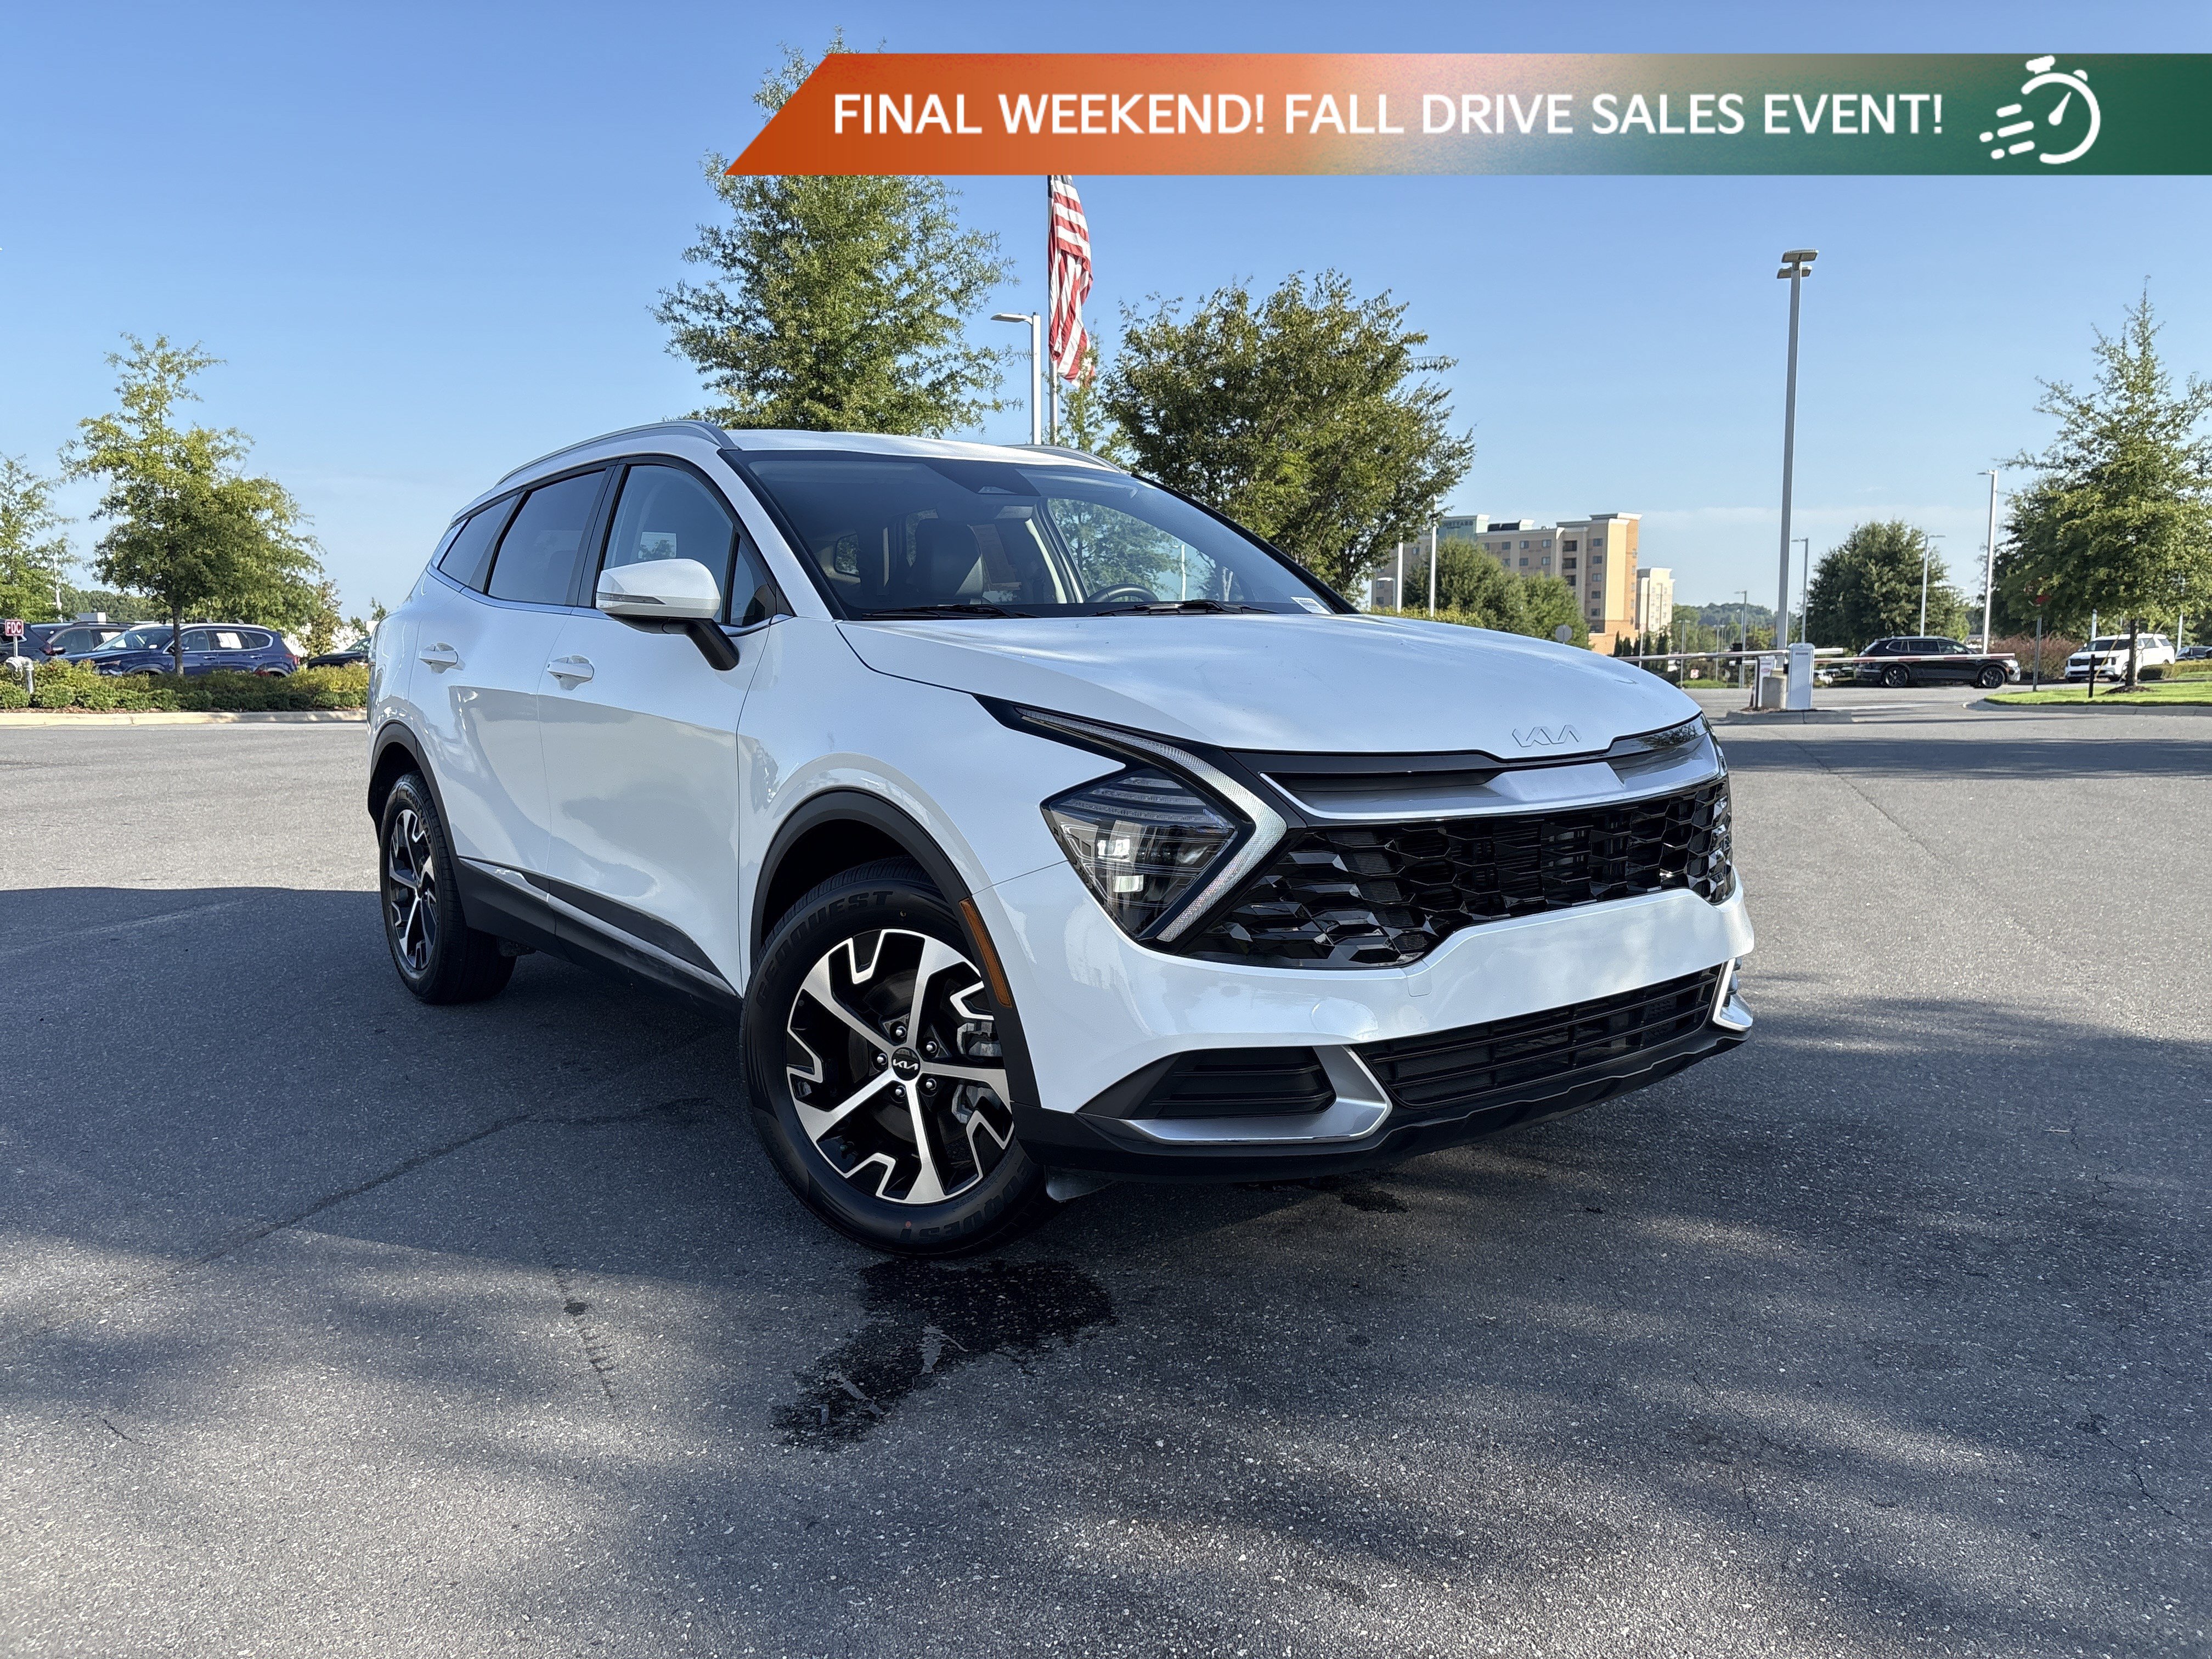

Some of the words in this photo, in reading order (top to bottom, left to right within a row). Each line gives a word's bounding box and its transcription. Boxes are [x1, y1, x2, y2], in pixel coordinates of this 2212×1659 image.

[7, 622, 21, 634] FDC
[1512, 724, 1582, 747] KIA
[893, 1059, 918, 1070] KIA
